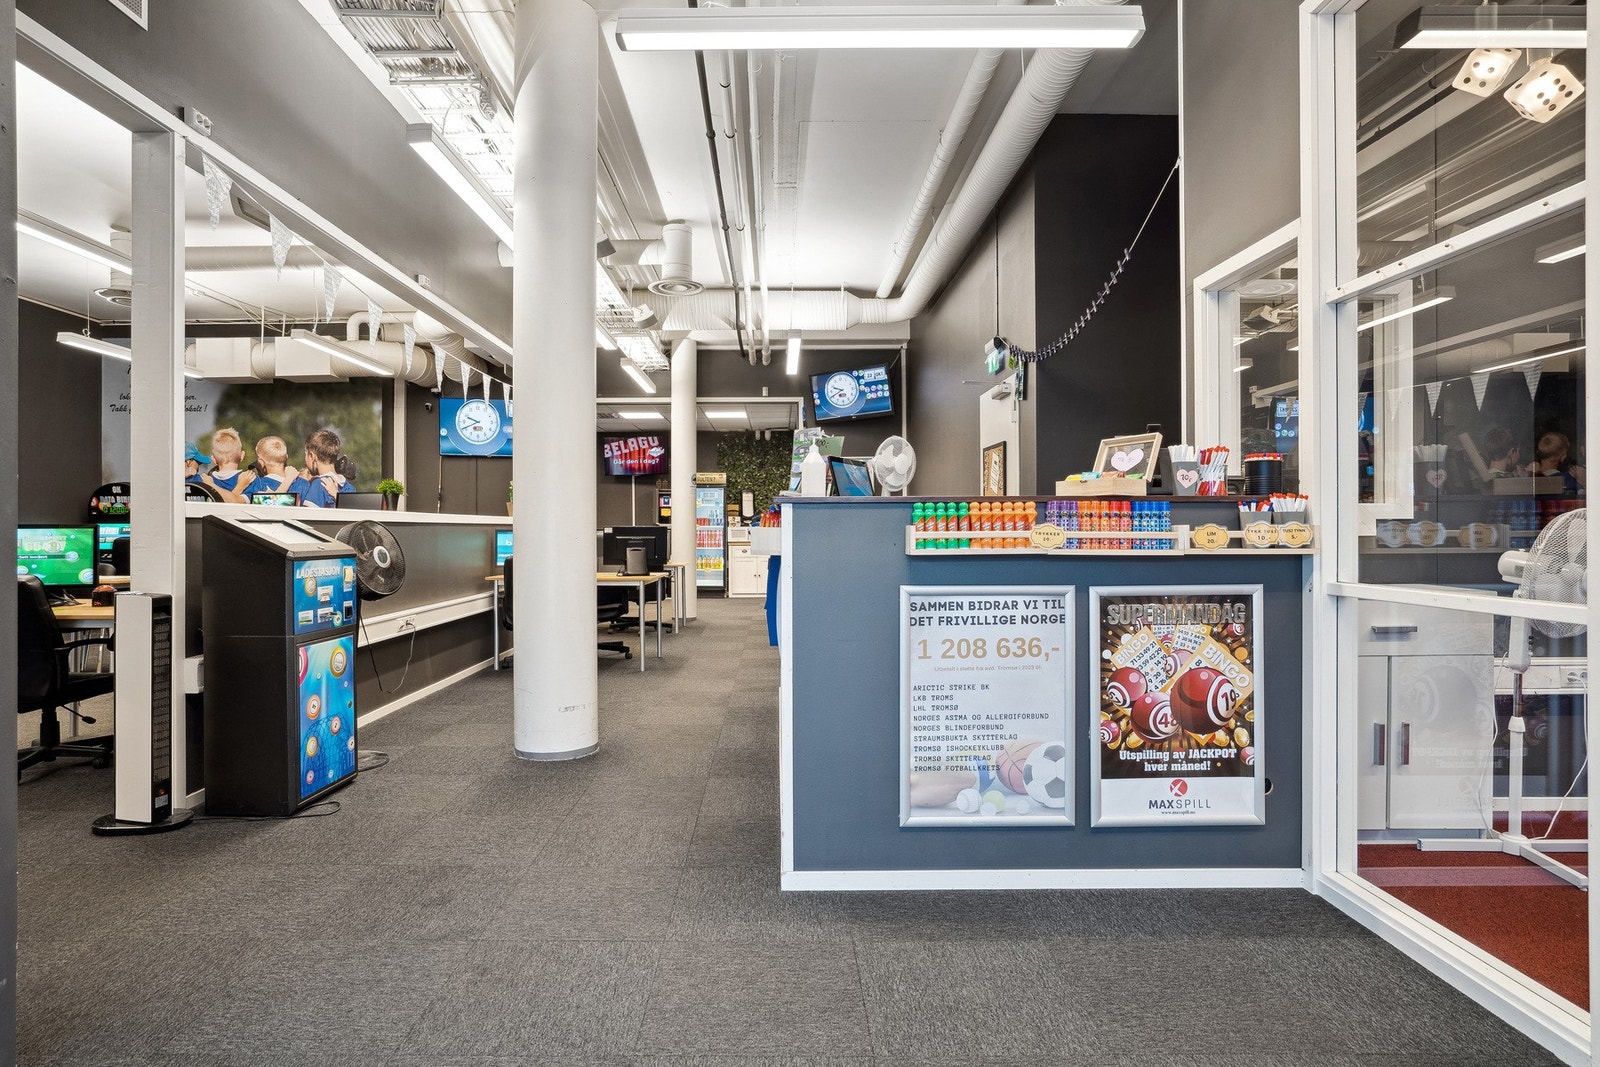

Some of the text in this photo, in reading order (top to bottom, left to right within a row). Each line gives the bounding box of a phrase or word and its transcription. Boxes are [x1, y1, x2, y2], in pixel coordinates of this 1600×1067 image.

[110, 404, 127, 412] Takk
[910, 599, 1064, 612] SAMMEN BIDRAR VI TIL
[910, 614, 1065, 626] DET FRIVILLIGE NORGE
[1107, 603, 1246, 625] SUPERMANDAG
[918, 637, 1060, 661] 1 208 636,-
[1117, 633, 1149, 665] BINGO
[1203, 644, 1250, 688] BINGO
[1221, 689, 1237, 711] 19
[1119, 750, 1169, 761] Utspilling
[1188, 749, 1237, 758] JACKPOT
[1144, 761, 1211, 771] hver måned!
[1149, 799, 1211, 809] MAXSPILL
